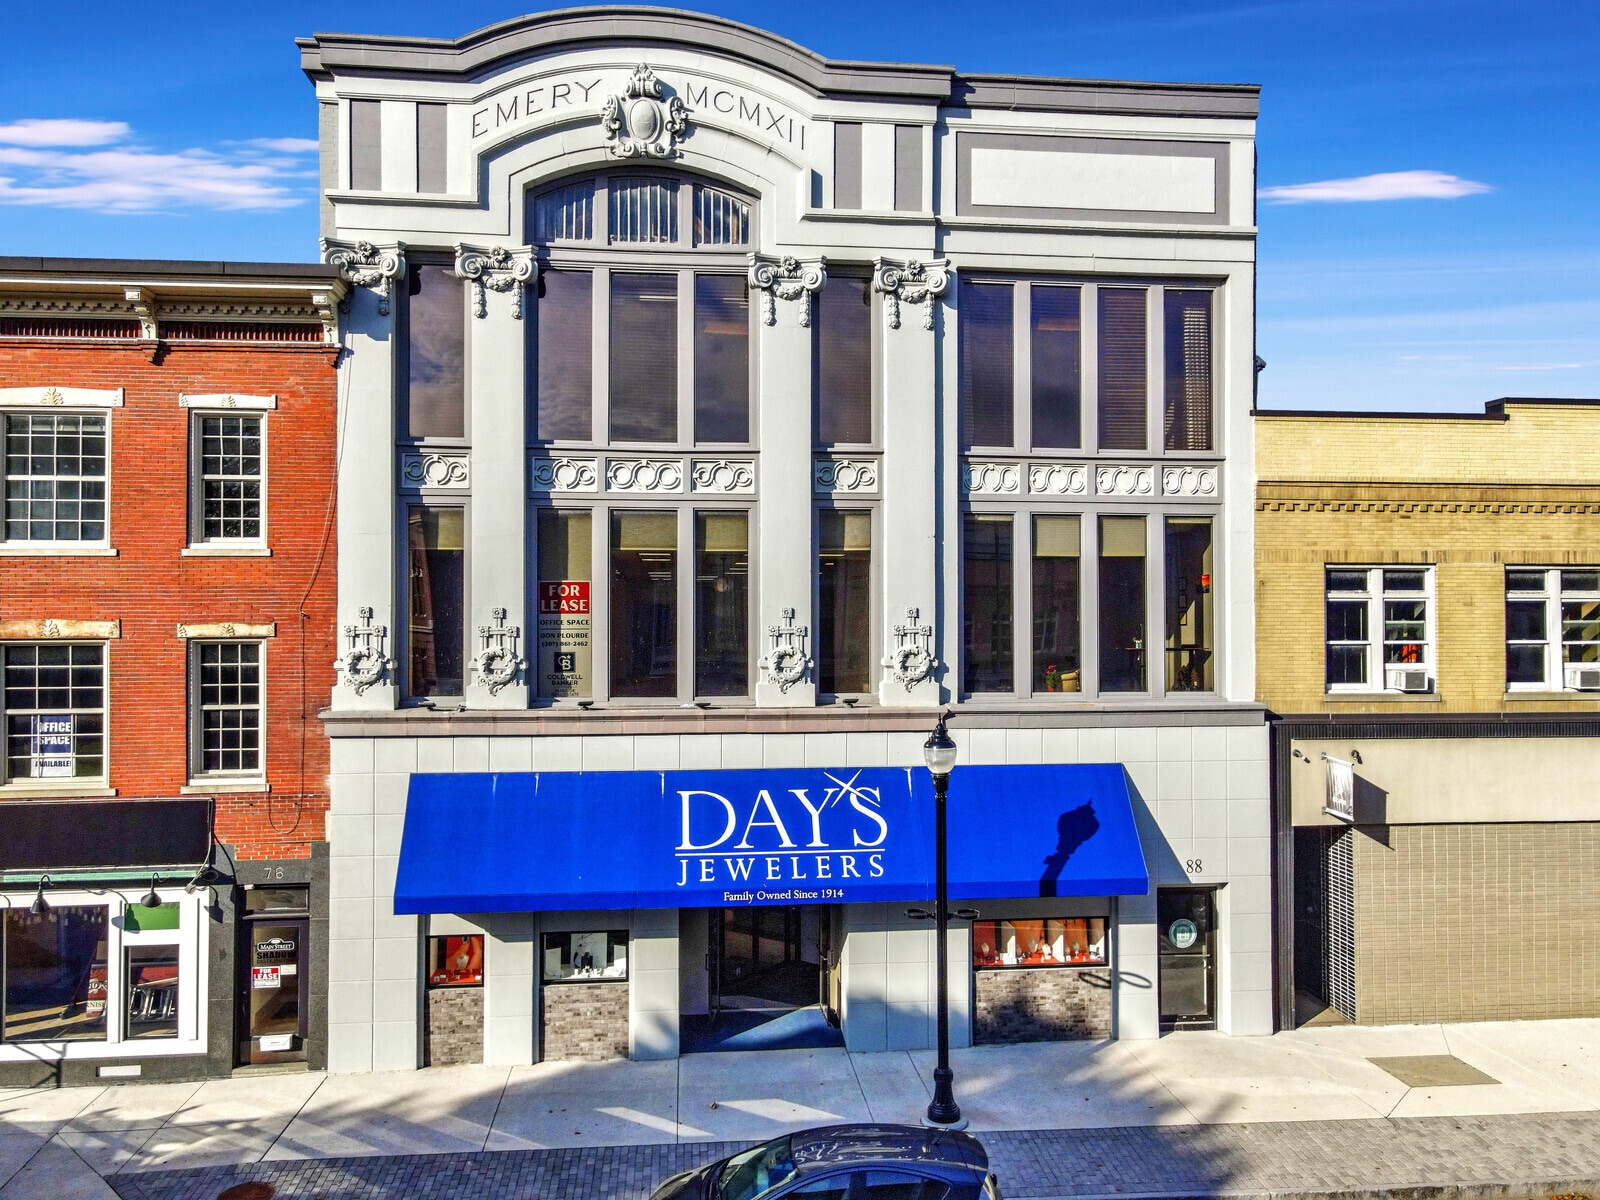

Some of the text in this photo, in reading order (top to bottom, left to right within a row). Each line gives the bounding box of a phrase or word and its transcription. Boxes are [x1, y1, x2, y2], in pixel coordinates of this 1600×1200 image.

[472, 79, 602, 139] EMERY
[687, 82, 806, 150] MCMXII
[548, 584, 580, 597] FOR
[541, 599, 588, 611] LEASE
[37, 721, 71, 732] OFFICE
[37, 735, 71, 745] SPACE
[674, 785, 888, 850] DAY'S
[263, 866, 284, 879] 76
[676, 853, 885, 887] JEWELERS
[1186, 858, 1203, 873] 88
[723, 888, 845, 904] Family Owned Since 1914
[253, 972, 278, 980] LEASE
